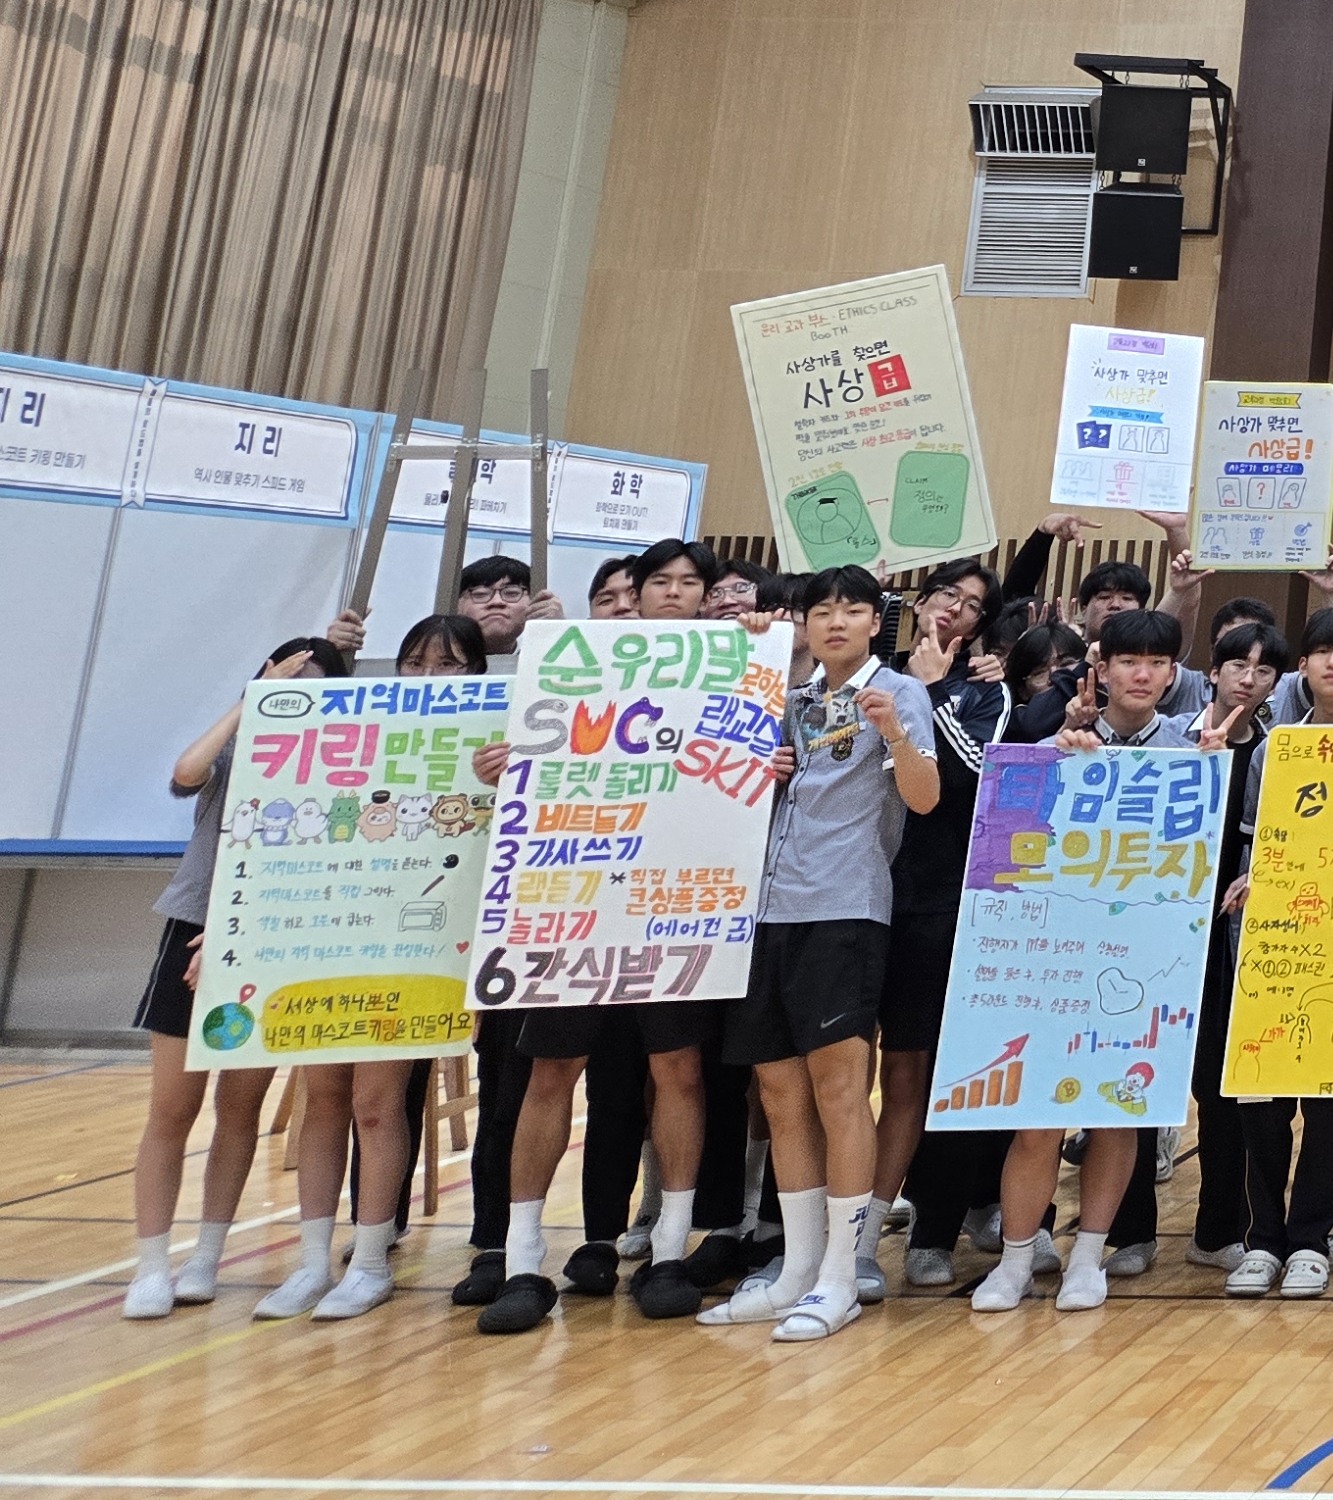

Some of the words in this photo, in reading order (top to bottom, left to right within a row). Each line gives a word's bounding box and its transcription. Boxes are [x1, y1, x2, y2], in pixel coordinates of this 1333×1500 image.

[786, 351, 841, 374] 사상가를
[853, 340, 890, 359] 찾으면
[1137, 369, 1168, 385] 맞추면
[1219, 416, 1262, 434] 사상가
[1267, 417, 1303, 433] 맞추면
[29, 449, 52, 465] 키링
[53, 452, 86, 469] 만들기
[1248, 438, 1314, 461] 사상급!
[195, 467, 212, 483] 역사
[215, 470, 233, 485] 인물
[234, 472, 259, 488] 맞추기
[262, 476, 286, 490] 스피드
[288, 479, 305, 493] 게임
[611, 471, 643, 498] 화학
[538, 625, 755, 696] 순우리말
[269, 698, 302, 711] 나만의
[320, 682, 509, 716] 지역마스코트
[251, 724, 380, 787] 키링
[1277, 733, 1315, 762] 몸으로
[534, 761, 599, 800] 룰렛
[604, 761, 679, 795] 돌리기
[674, 739, 777, 807] SKIT
[999, 755, 1220, 842] 타임슬립
[499, 805, 529, 835] 2
[491, 842, 520, 873] 3
[993, 828, 1212, 898] 모의투자
[485, 874, 511, 904] 4
[631, 869, 667, 884] 직접
[676, 868, 735, 886] 부르면
[481, 909, 506, 934] 5
[507, 909, 598, 945] 놀라기
[475, 946, 516, 1006] 6
[517, 944, 713, 1005] 간식받기
[284, 995, 333, 1015] 세상에
[266, 1025, 304, 1048] 나만의
[410, 1012, 472, 1039] 만들어요
